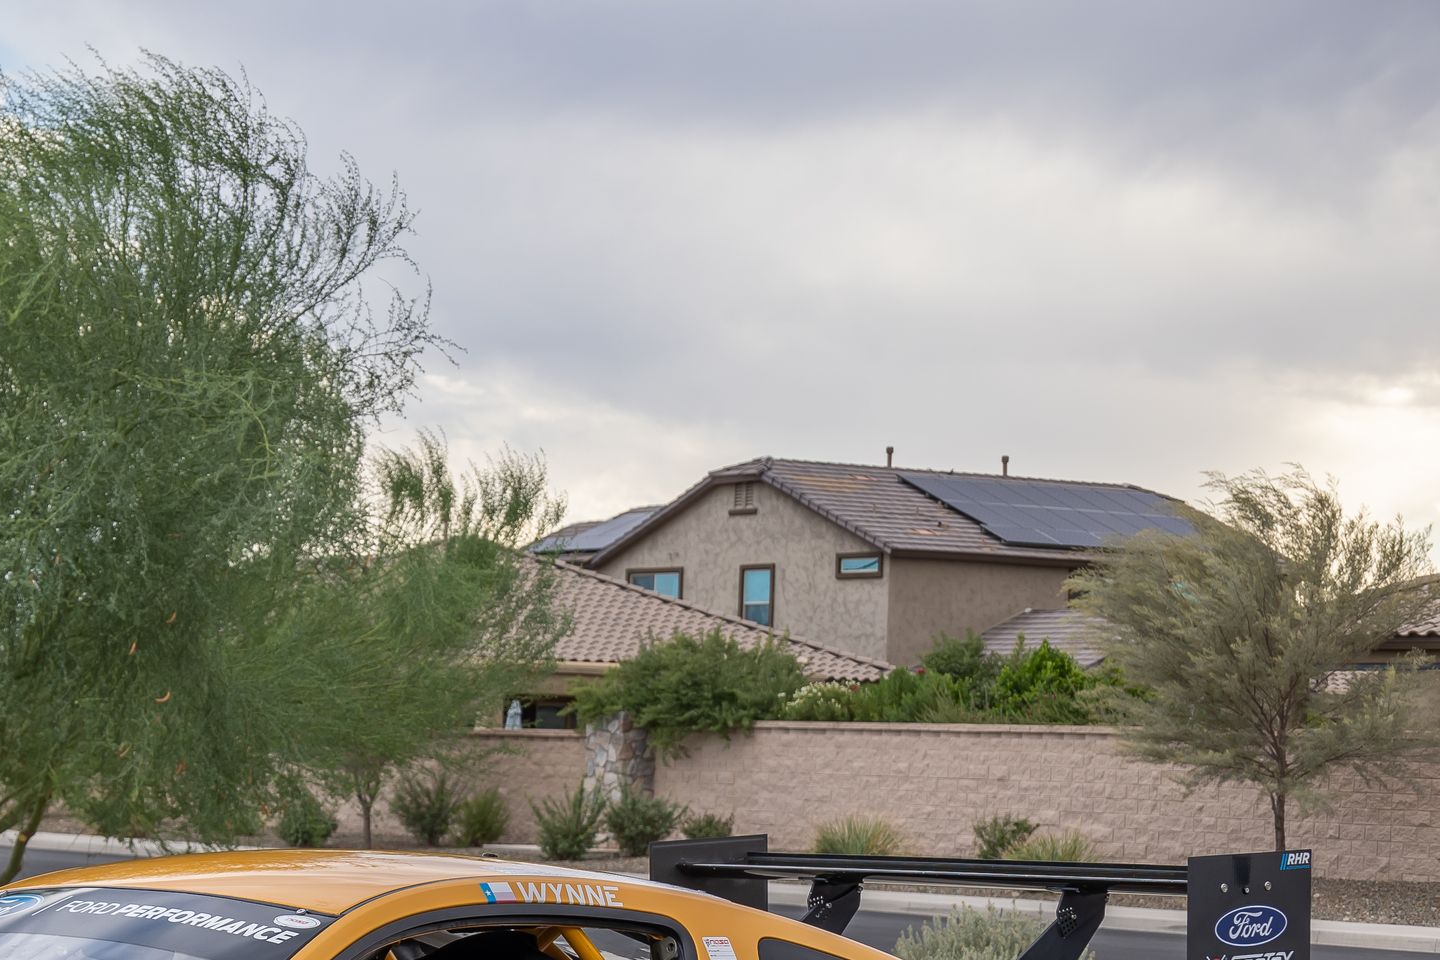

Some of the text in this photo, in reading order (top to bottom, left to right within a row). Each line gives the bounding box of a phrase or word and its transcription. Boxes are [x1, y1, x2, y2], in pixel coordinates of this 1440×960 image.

[1286, 852, 1311, 865] RHR
[516, 881, 624, 907] WYNNE
[56, 900, 300, 945] FORD PERFORMANCE
[1228, 911, 1274, 939] Ford
